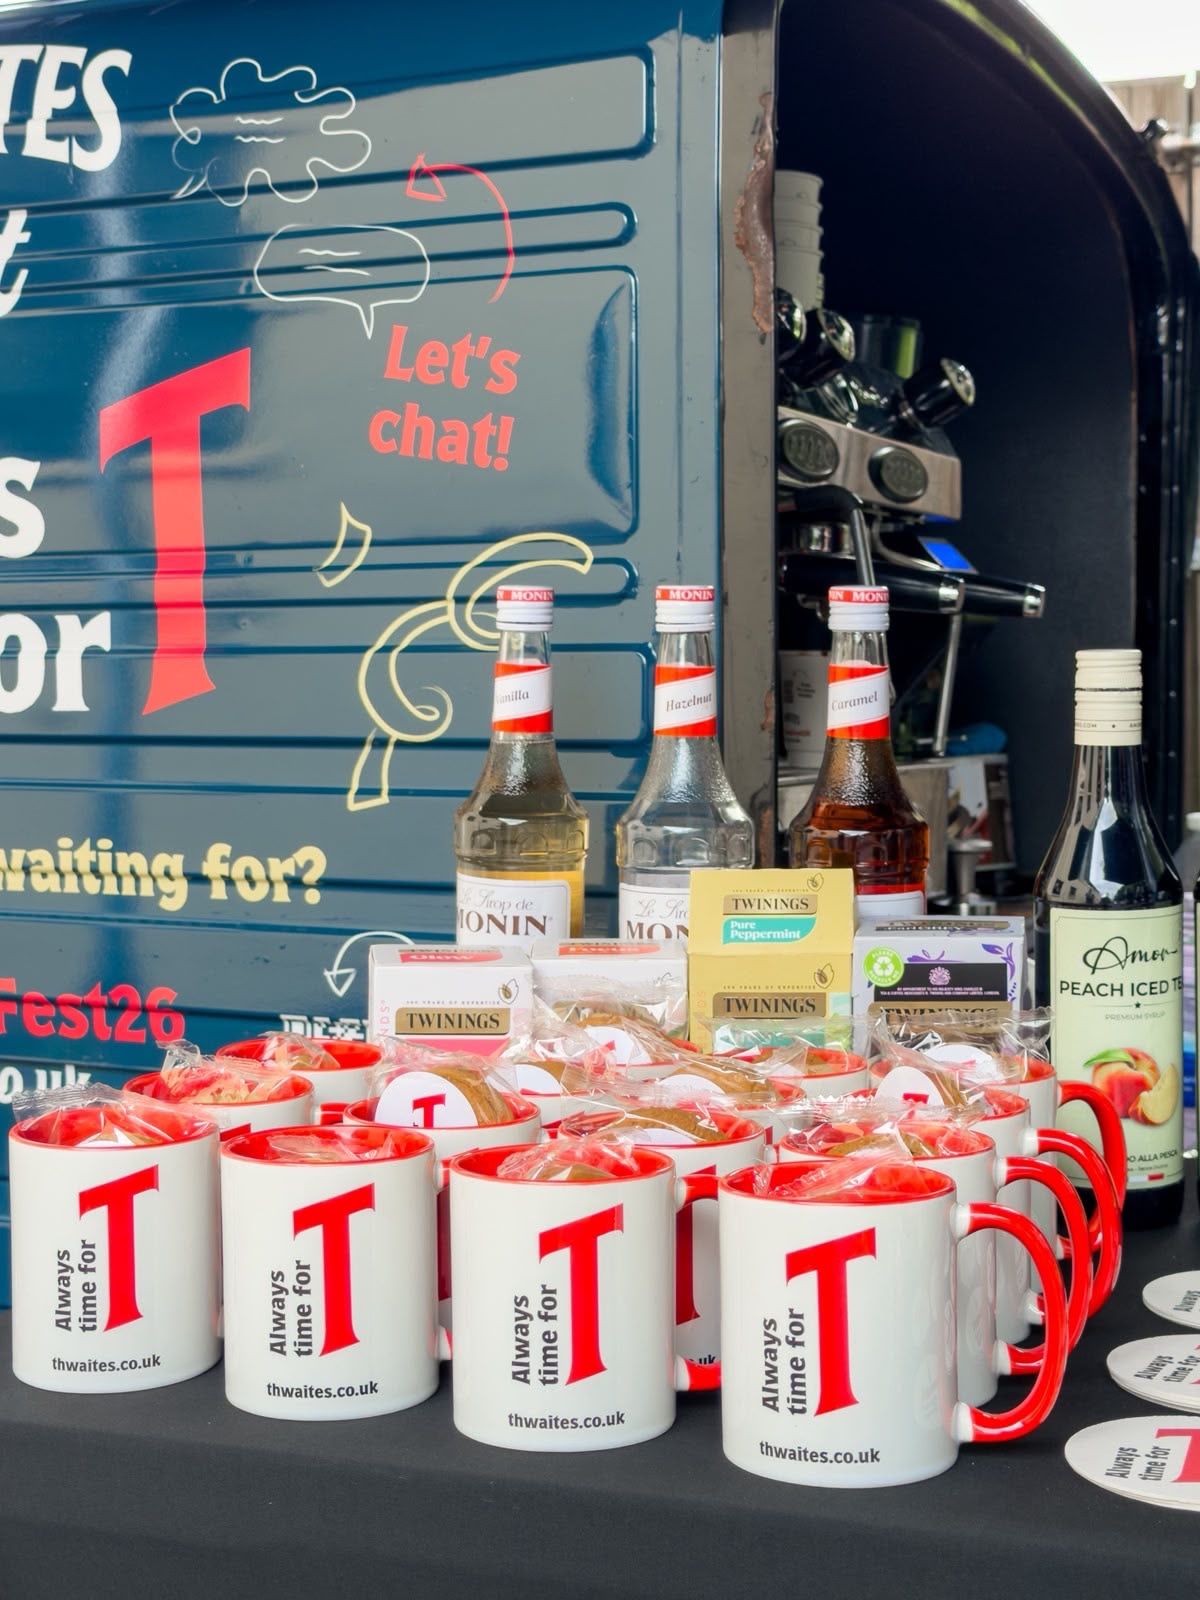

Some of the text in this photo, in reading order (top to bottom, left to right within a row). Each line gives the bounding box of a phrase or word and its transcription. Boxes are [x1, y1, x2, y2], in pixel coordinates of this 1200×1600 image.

[0, 45, 132, 171] TES
[384, 324, 521, 395] Let's
[368, 402, 515, 471] chat!
[100, 347, 251, 716] T
[852, 591, 889, 602] MONI
[666, 693, 712, 712] Hazelnut
[831, 691, 878, 711] Caramel
[203, 843, 327, 905] for?
[730, 920, 757, 930] Pure
[732, 897, 809, 910] TWININGS
[626, 920, 689, 940] MON
[730, 930, 801, 940] Peppermint
[0, 976, 186, 1043] Fest26
[722, 997, 817, 1013] TWININGS
[1059, 980, 1124, 997] PEACH
[1131, 980, 1170, 997] ICED
[406, 1013, 500, 1029] TWININGS
[78, 1164, 160, 1332] T
[292, 1182, 376, 1357] T
[54, 1248, 75, 1332] Always
[78, 1239, 97, 1333] time for
[293, 1259, 313, 1357] time for
[538, 1202, 624, 1387] T
[268, 1269, 290, 1356] Always
[538, 1283, 559, 1387] time for
[786, 1227, 877, 1417] T
[52, 1355, 161, 1373] thwaites.co.uk
[511, 1294, 535, 1386] Always
[788, 1307, 808, 1416] time for
[762, 1317, 788, 1413] Always
[1133, 1355, 1174, 1380] Always
[1162, 1367, 1193, 1383] time
[267, 1381, 379, 1399] thwaites.co.uk
[508, 1411, 626, 1430] thwaites.co.uk
[759, 1441, 881, 1465] thwaites.co.uk
[1104, 1447, 1141, 1479] Always
[1138, 1446, 1171, 1481] time for
